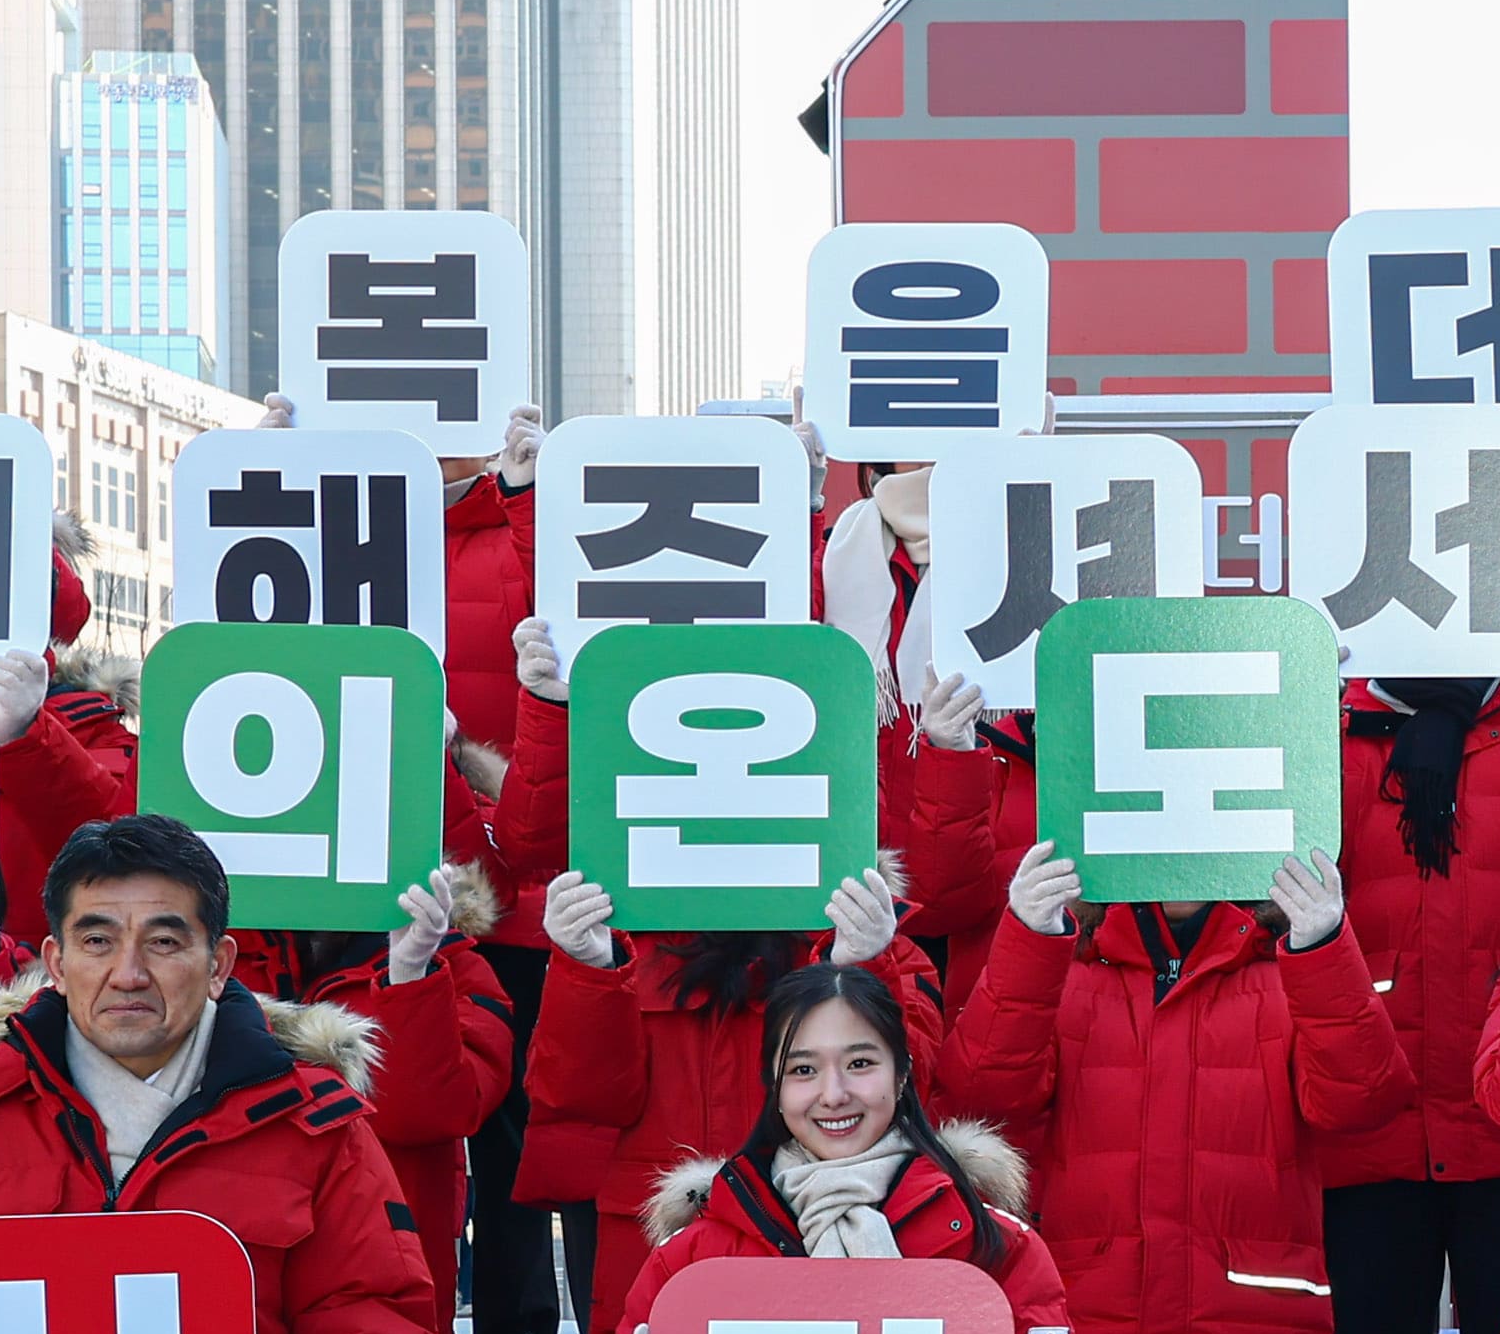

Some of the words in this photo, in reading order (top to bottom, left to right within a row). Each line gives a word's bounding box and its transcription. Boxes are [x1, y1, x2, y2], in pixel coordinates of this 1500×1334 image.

[317, 254, 488, 422] 복
[841, 262, 1009, 428] 을
[209, 470, 407, 625] 해
[575, 466, 769, 623] 주
[964, 480, 1156, 662] 셔
[181, 671, 393, 884] 의
[615, 673, 830, 888] 온
[1082, 652, 1295, 854] 도
